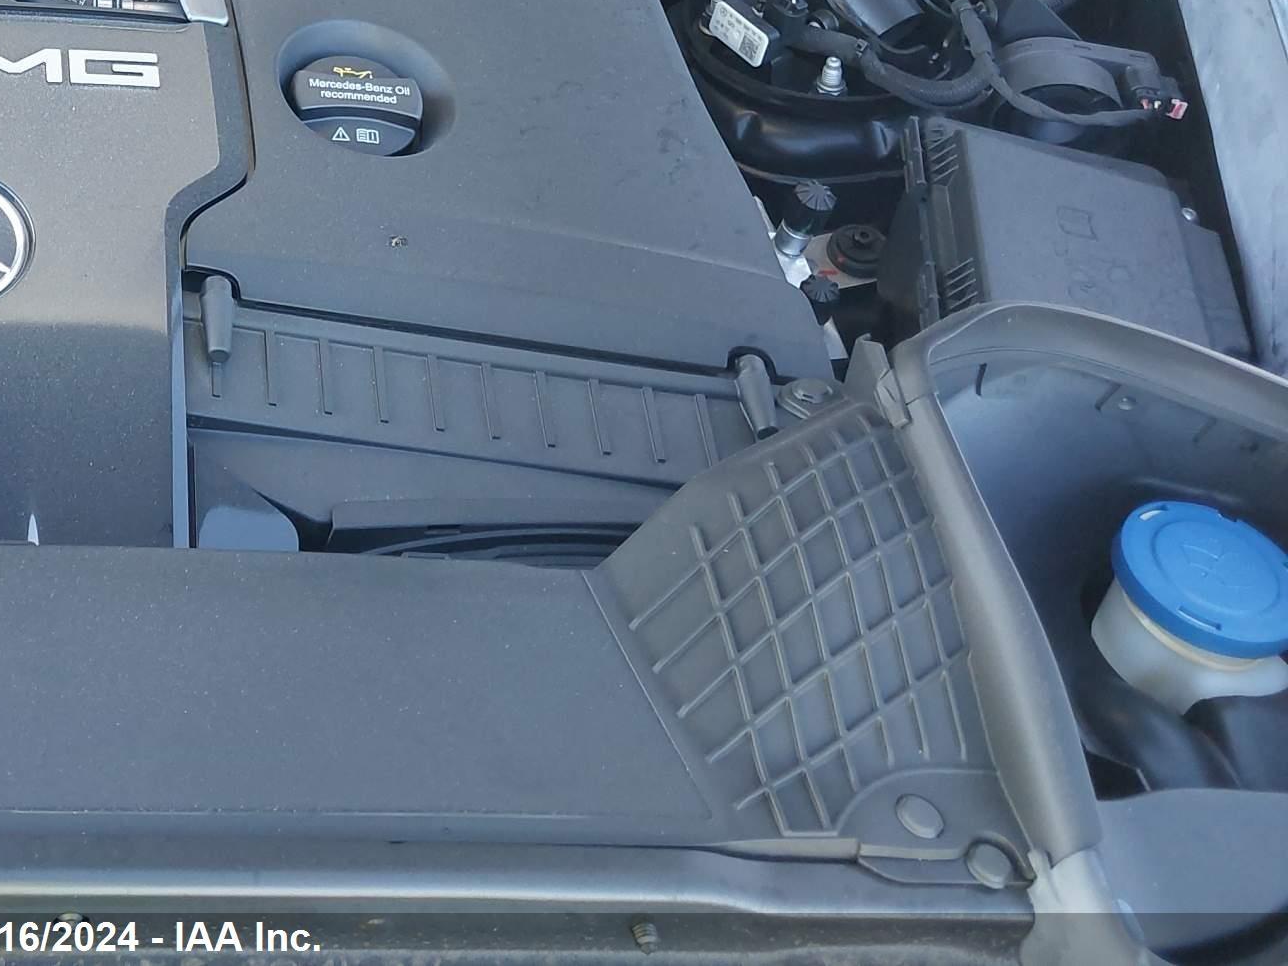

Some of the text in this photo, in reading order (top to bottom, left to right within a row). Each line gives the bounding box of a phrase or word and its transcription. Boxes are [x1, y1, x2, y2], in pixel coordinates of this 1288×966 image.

[309, 78, 411, 96] Mercedes-Benz Oil
[320, 90, 397, 105] recommended
